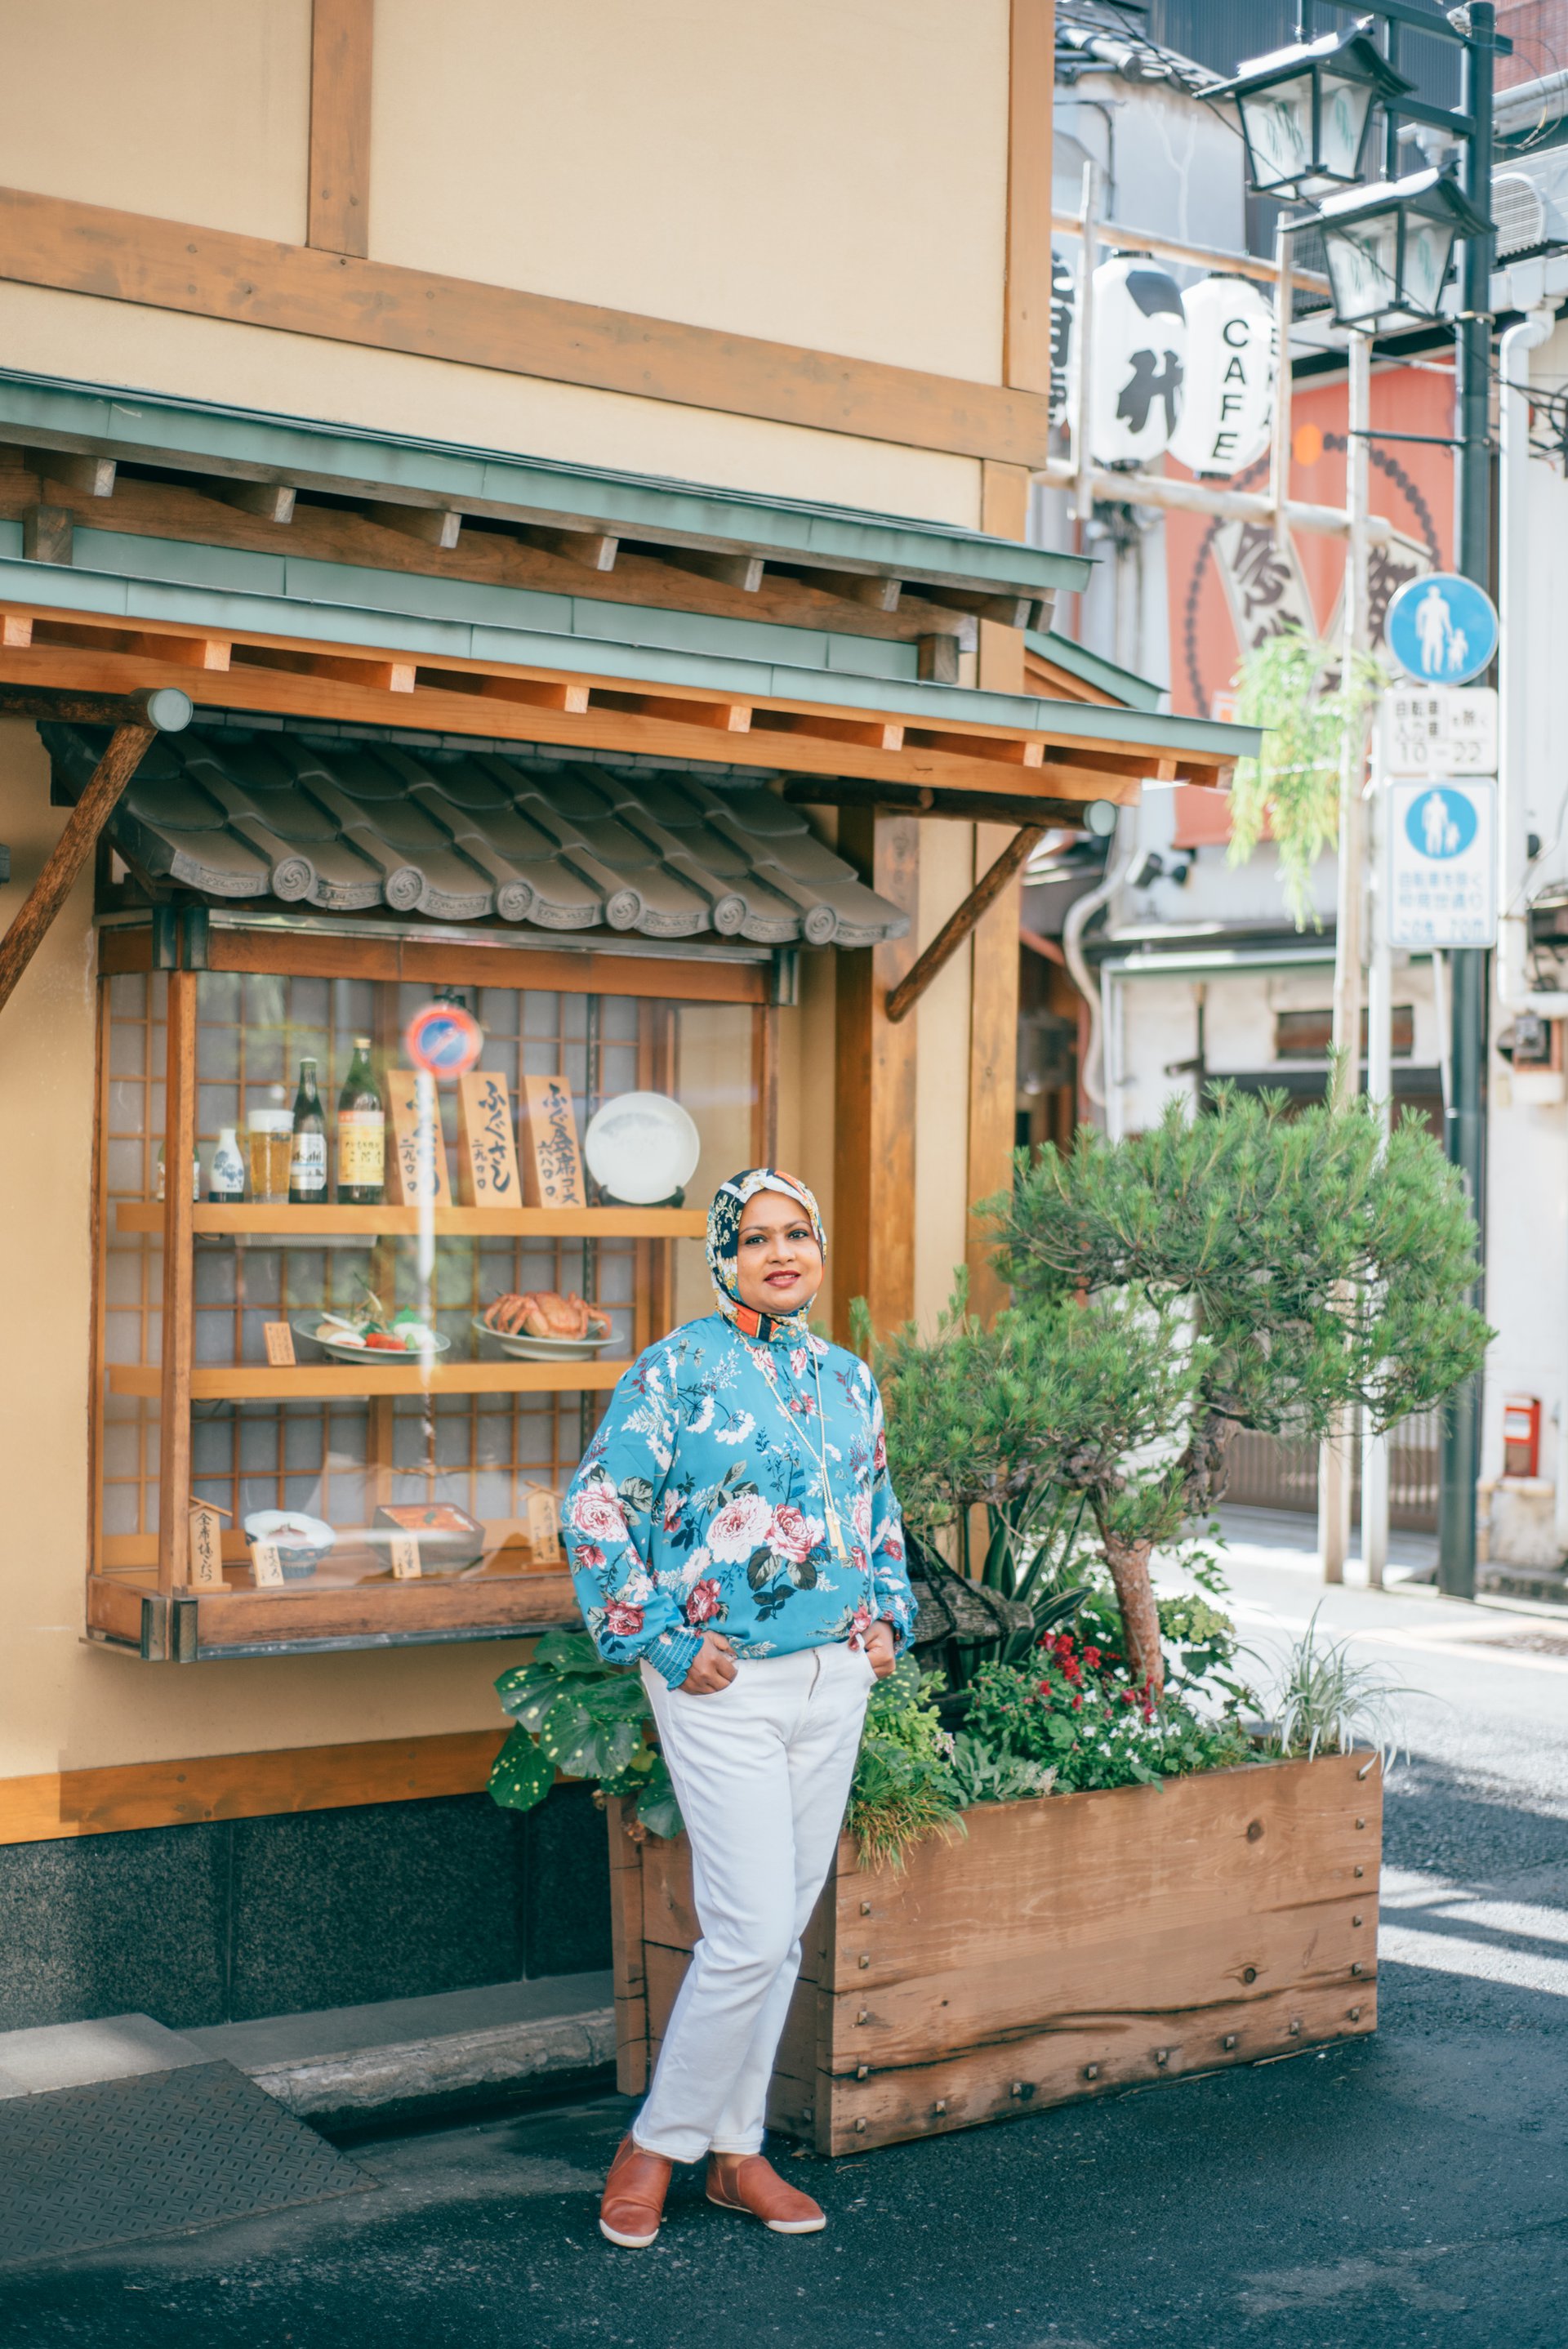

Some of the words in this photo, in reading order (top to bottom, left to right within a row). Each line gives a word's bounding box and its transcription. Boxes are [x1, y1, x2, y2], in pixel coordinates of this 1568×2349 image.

[1212, 319, 1250, 460] CAFE
[479, 1080, 510, 1193] ふぐさし
